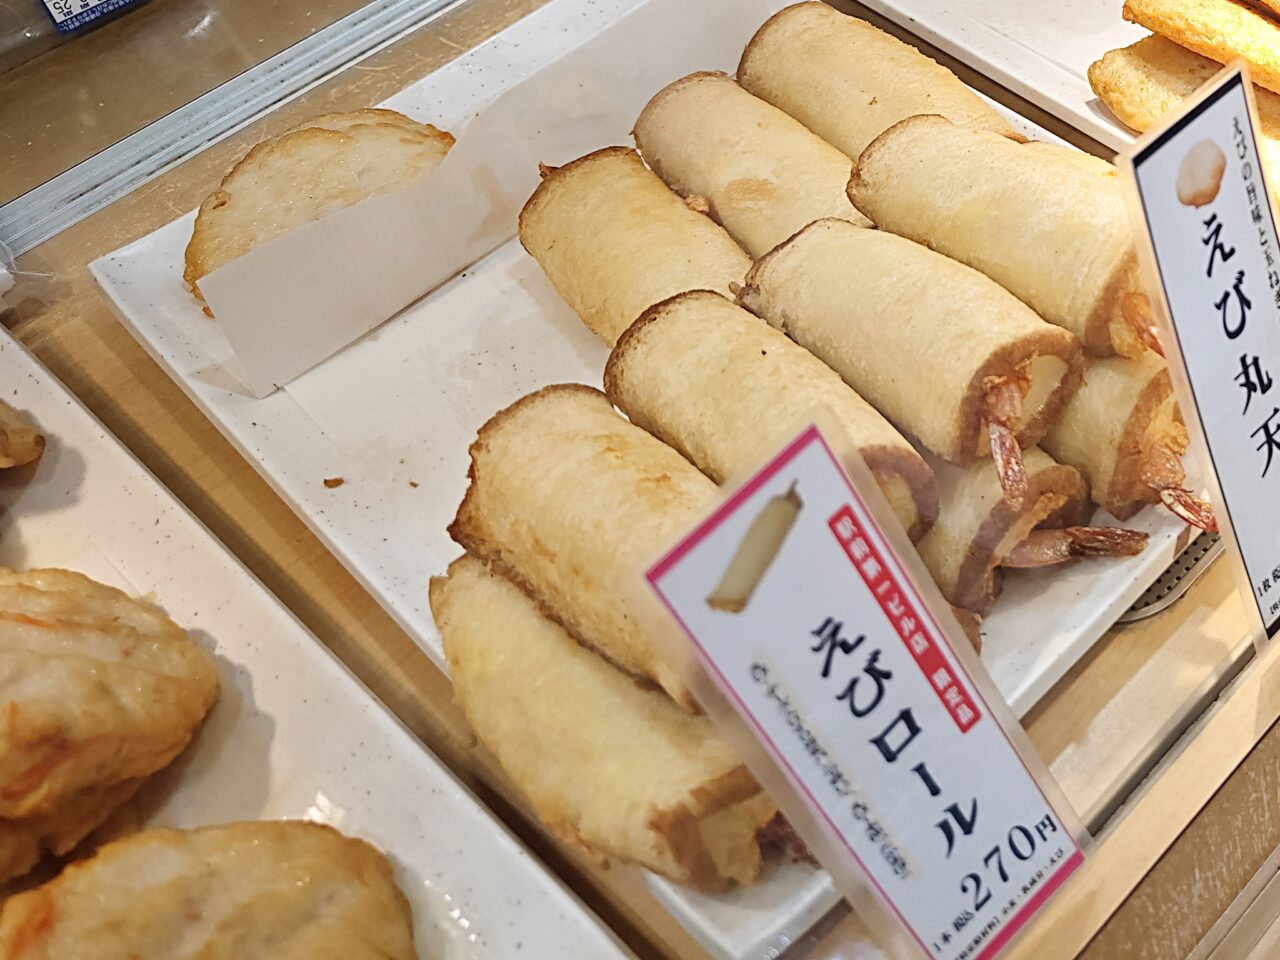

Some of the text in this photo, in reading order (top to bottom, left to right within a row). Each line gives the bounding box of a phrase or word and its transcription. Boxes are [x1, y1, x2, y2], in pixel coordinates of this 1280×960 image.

[836, 515, 975, 728] 駅前第一ビル店 限定品
[811, 617, 978, 858] えびロール
[961, 814, 1057, 911] 270円
